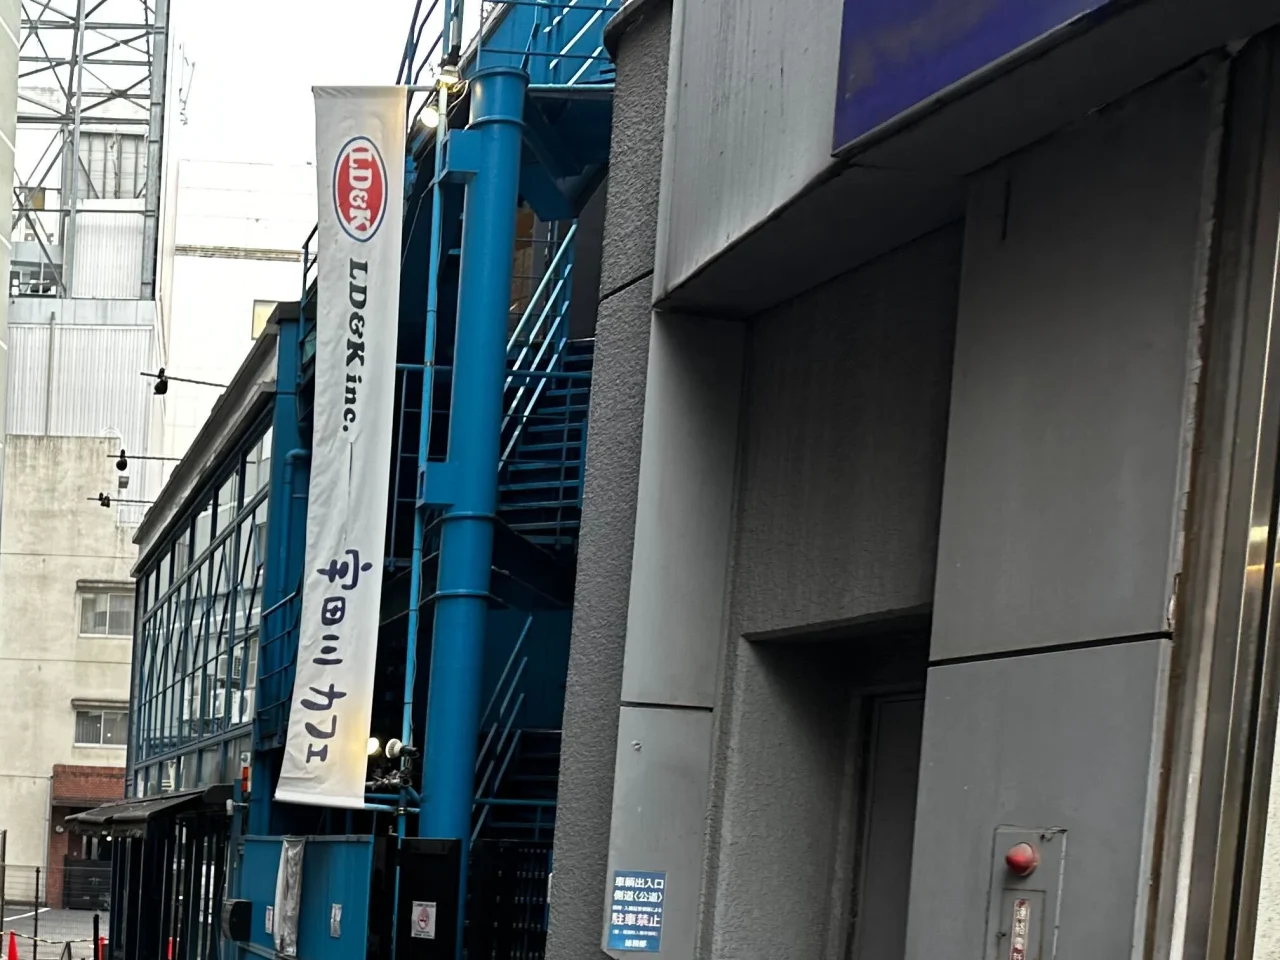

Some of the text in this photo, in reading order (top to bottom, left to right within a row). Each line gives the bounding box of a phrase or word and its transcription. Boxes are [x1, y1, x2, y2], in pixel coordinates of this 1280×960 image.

[347, 146, 373, 232] LD&K
[342, 258, 368, 432] LD&K inc.
[300, 549, 373, 764] 宇田川カフェ
[611, 912, 661, 927] 駐車禁止
